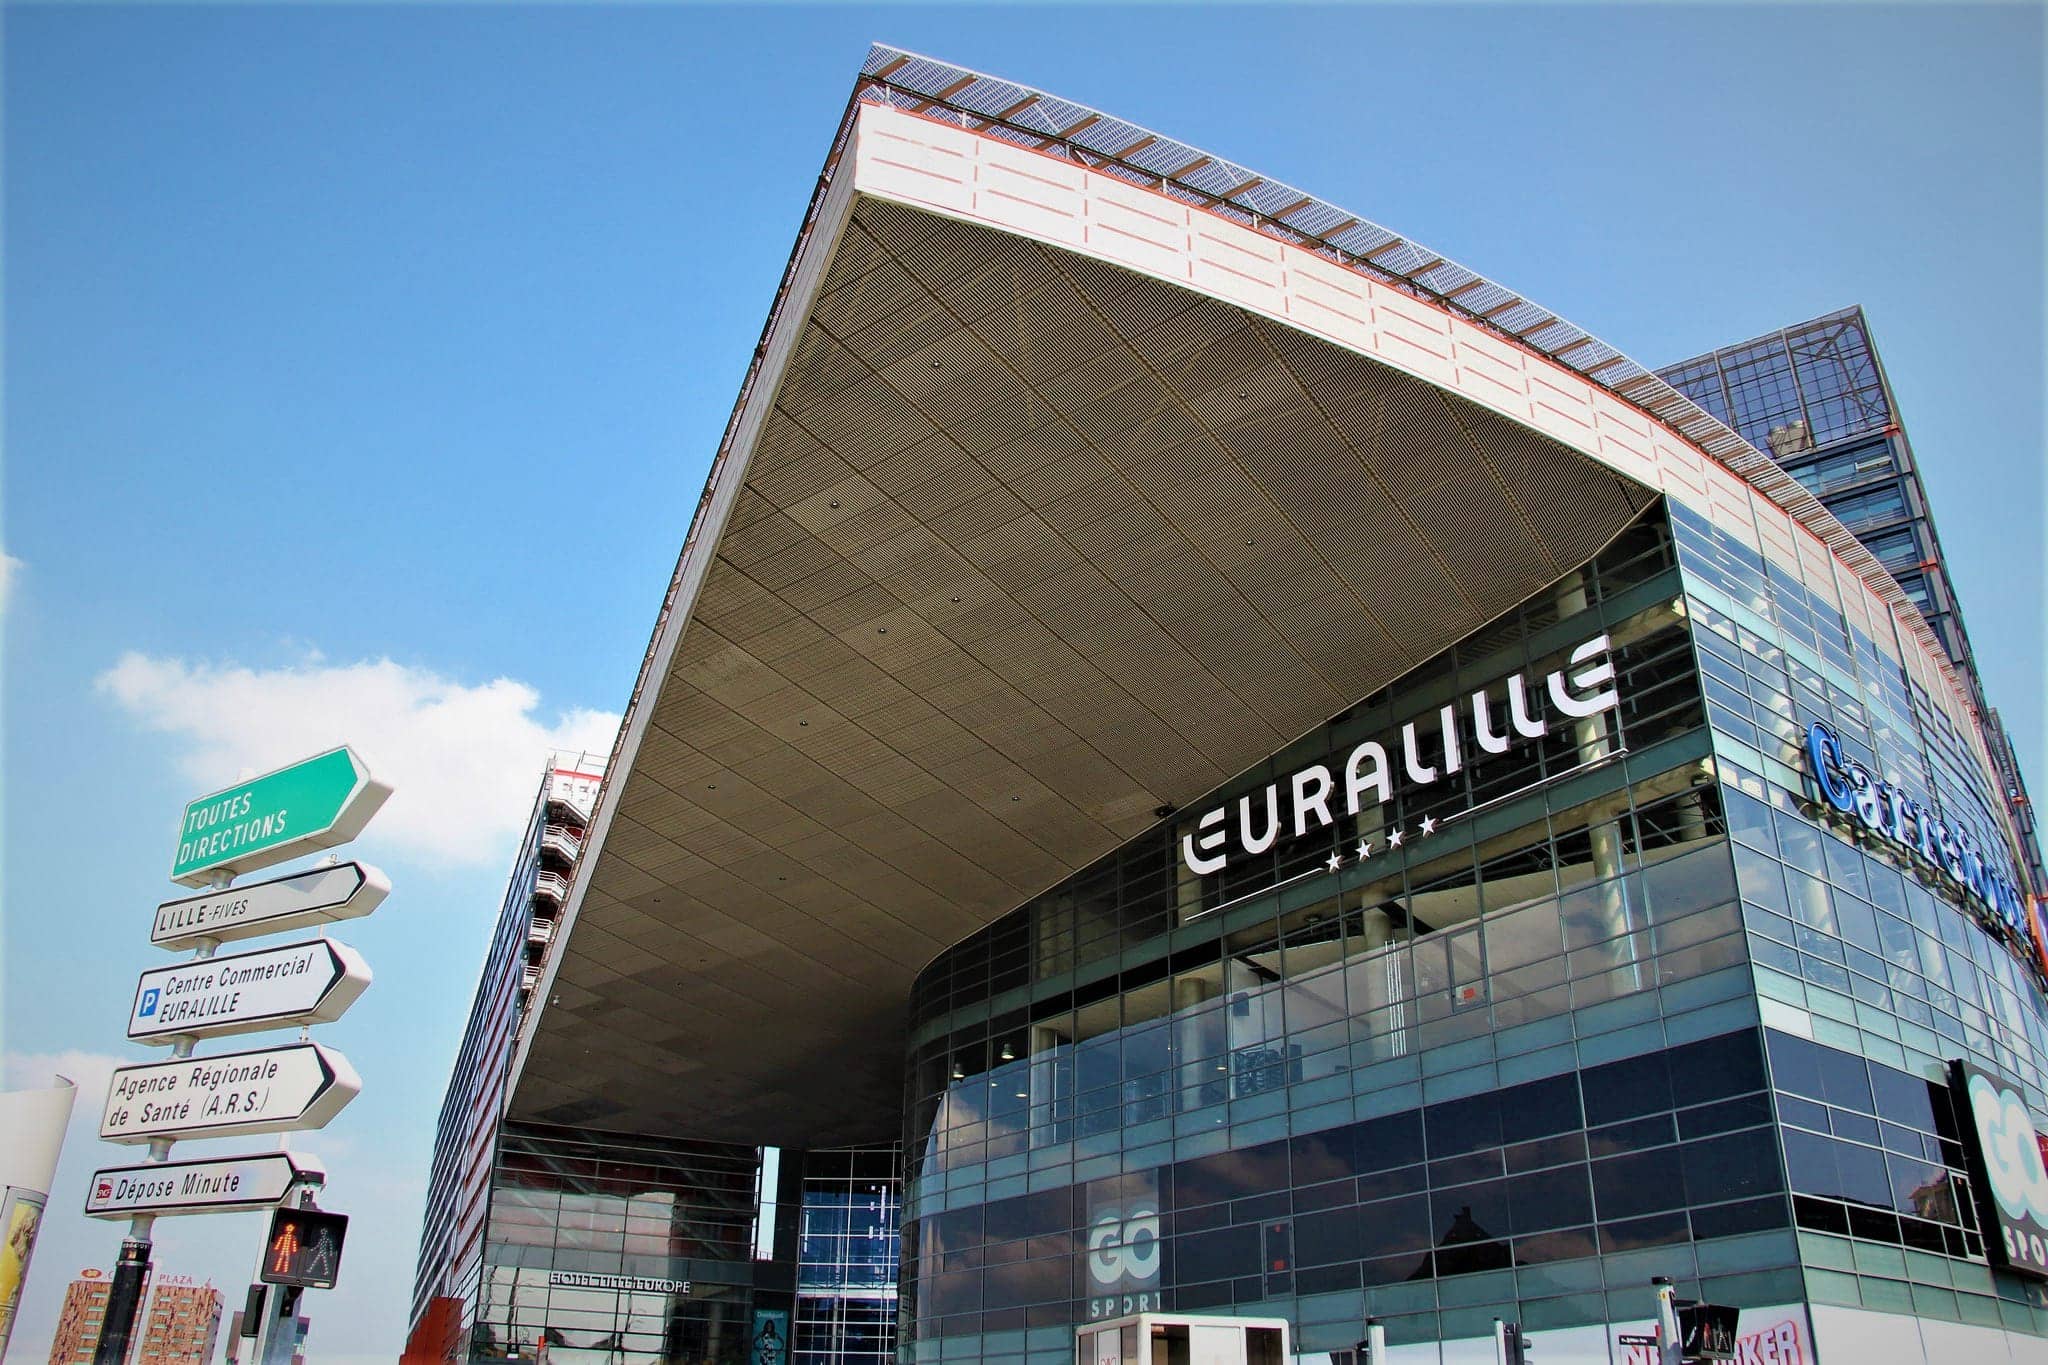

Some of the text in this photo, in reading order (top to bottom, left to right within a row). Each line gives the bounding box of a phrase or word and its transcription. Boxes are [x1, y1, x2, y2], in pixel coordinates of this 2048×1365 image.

[1183, 633, 1619, 877] EURALILLE
[188, 792, 252, 833] TOUTES
[179, 809, 287, 865] DIRECTIONS
[165, 952, 314, 996] Centre Commercial
[159, 992, 240, 1023] EURALILLE
[115, 1058, 278, 1101] Agence Régionale
[109, 1087, 270, 1127] de Santé (A.R.S.)
[1969, 1076, 2048, 1226] GO
[115, 1172, 240, 1204] Dépose Minute
[1088, 1209, 1160, 1285] GO
[2003, 1225, 2048, 1267] SPO
[159, 1273, 193, 1284] PLAZA
